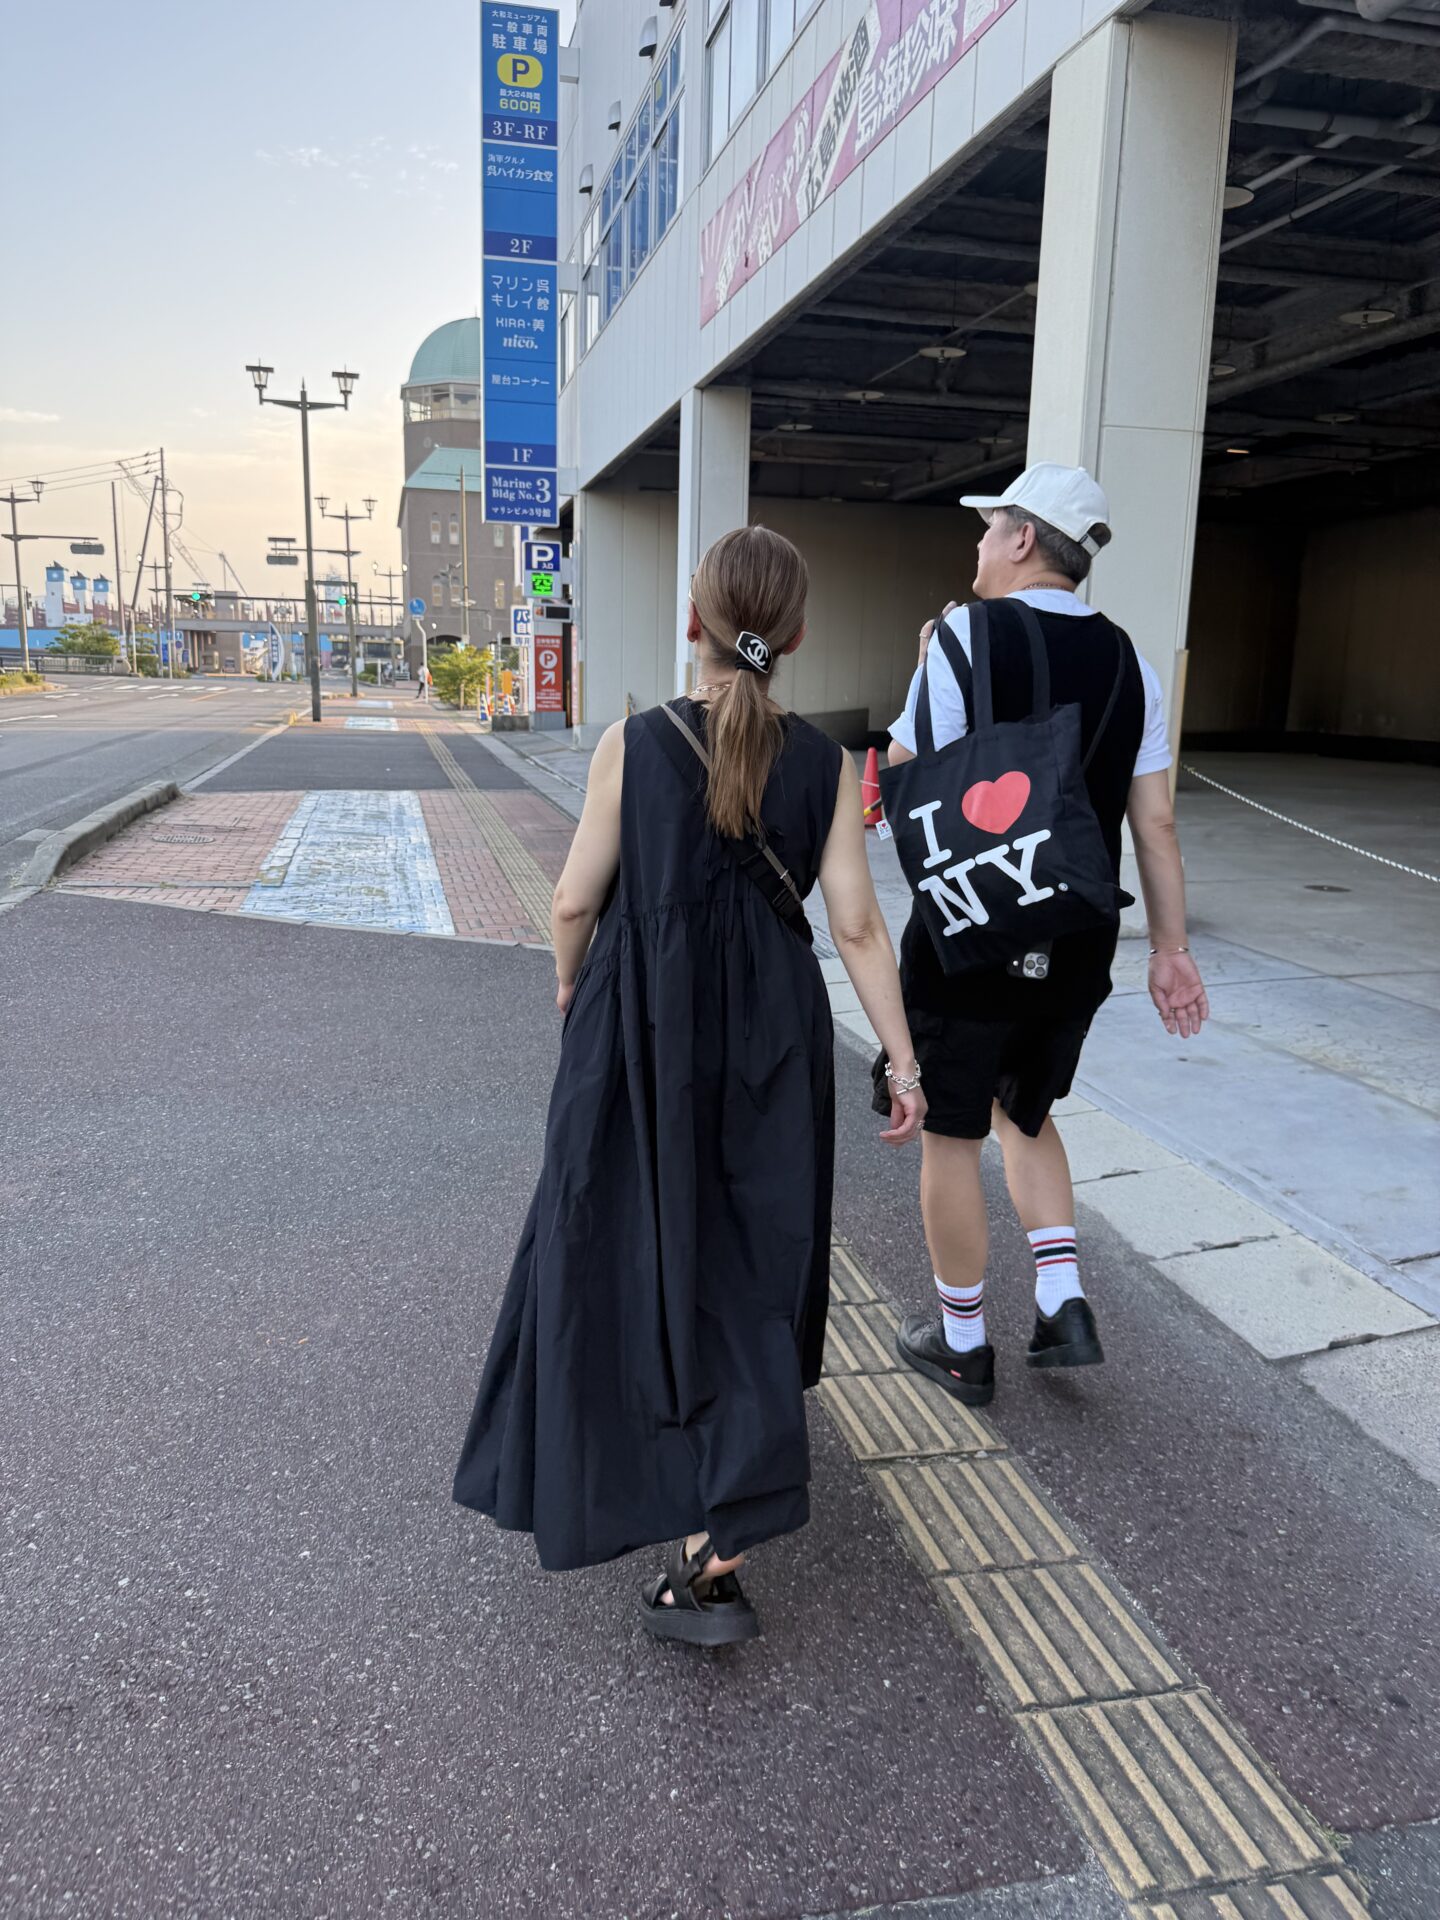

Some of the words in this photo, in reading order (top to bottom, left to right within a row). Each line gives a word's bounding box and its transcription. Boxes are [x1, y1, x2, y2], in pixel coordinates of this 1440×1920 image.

[492, 10, 547, 23] 大和ミュージアム
[492, 22, 548, 38] 一般車両
[492, 34, 547, 55] 駐車場
[512, 58, 530, 82] P
[500, 89, 541, 100] 最大24時間
[499, 98, 541, 114] 600円
[486, 165, 554, 183] 呉ハイカラ食堂
[510, 238, 533, 254] 2F
[491, 275, 550, 294] マリン呉
[491, 374, 550, 387] 屋台コーナー
[512, 447, 533, 463] 1F
[492, 476, 532, 490] Marine
[492, 489, 516, 502] Bldg
[491, 506, 552, 518] マリンビル3号館
[531, 544, 554, 569] P
[544, 653, 553, 666] P
[908, 800, 952, 869] I
